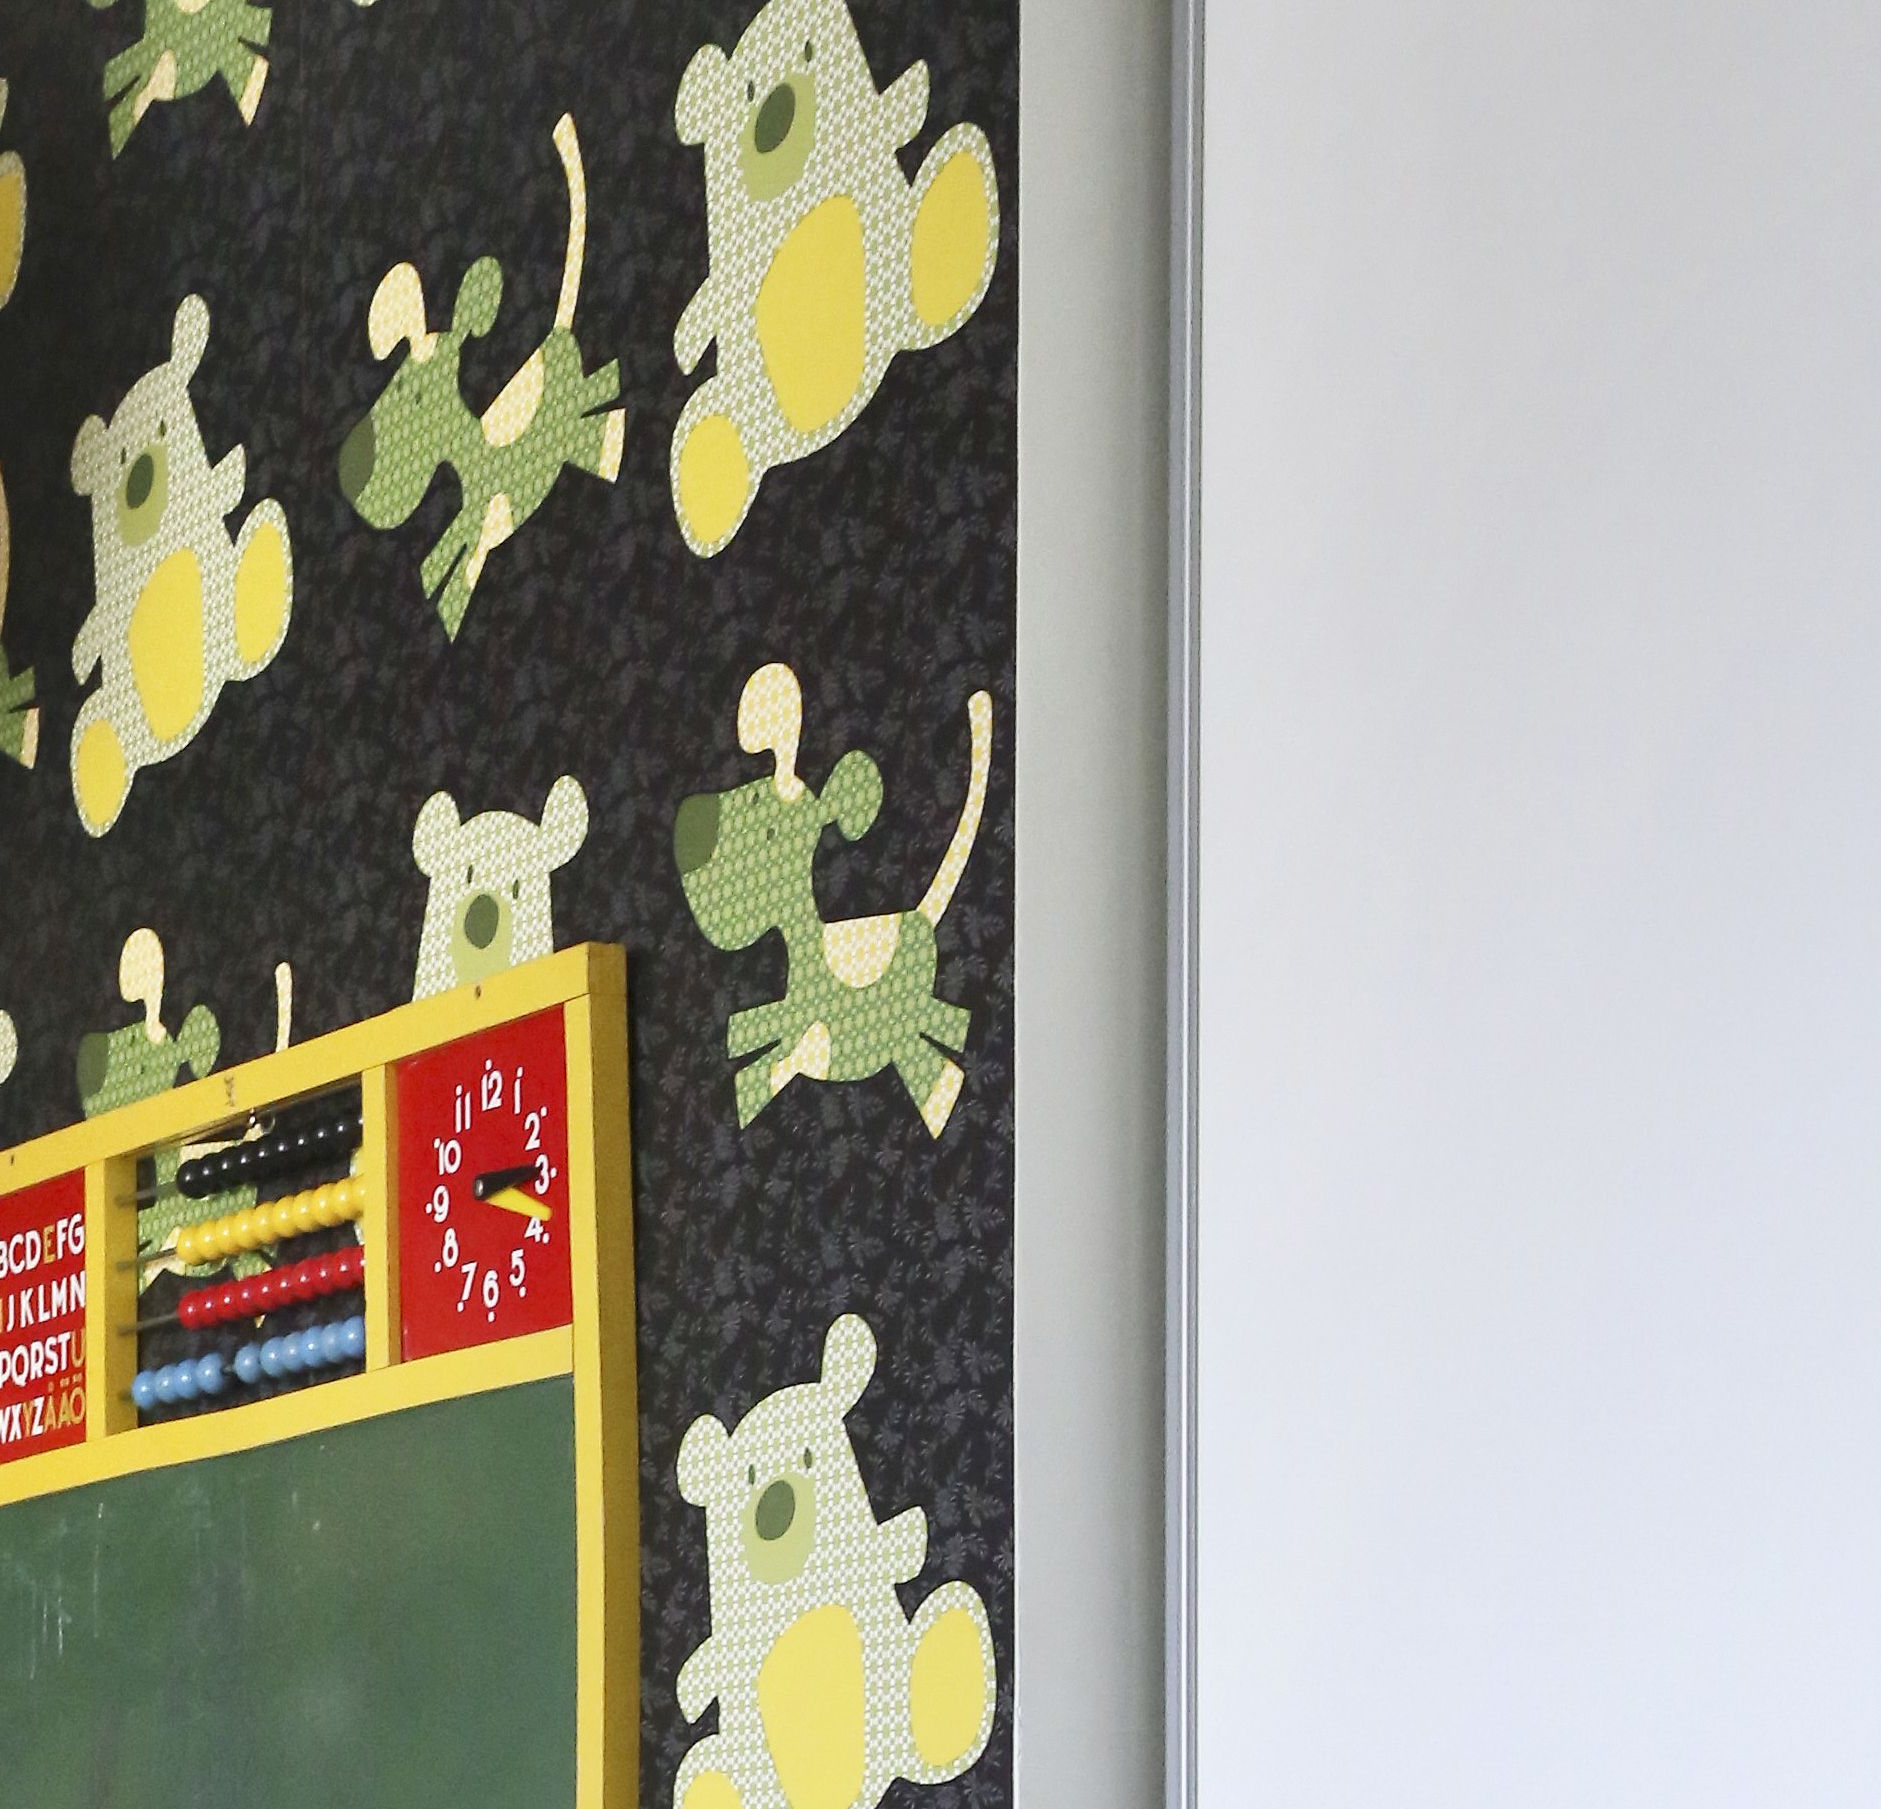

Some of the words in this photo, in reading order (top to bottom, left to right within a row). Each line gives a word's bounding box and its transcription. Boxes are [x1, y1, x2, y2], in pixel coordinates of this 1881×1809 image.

[481, 1069, 503, 1111] 12
[513, 1076, 521, 1114] 1
[455, 1092, 471, 1133] 11
[524, 1112, 541, 1150] 2
[437, 1140, 461, 1175] 10
[535, 1154, 549, 1195] 3
[432, 1185, 449, 1223] 9
[442, 1227, 458, 1268] 8
[524, 1215, 543, 1243] 4
[460, 1262, 477, 1300] 7
[509, 1249, 525, 1287] 5
[482, 1270, 499, 1308] 6
